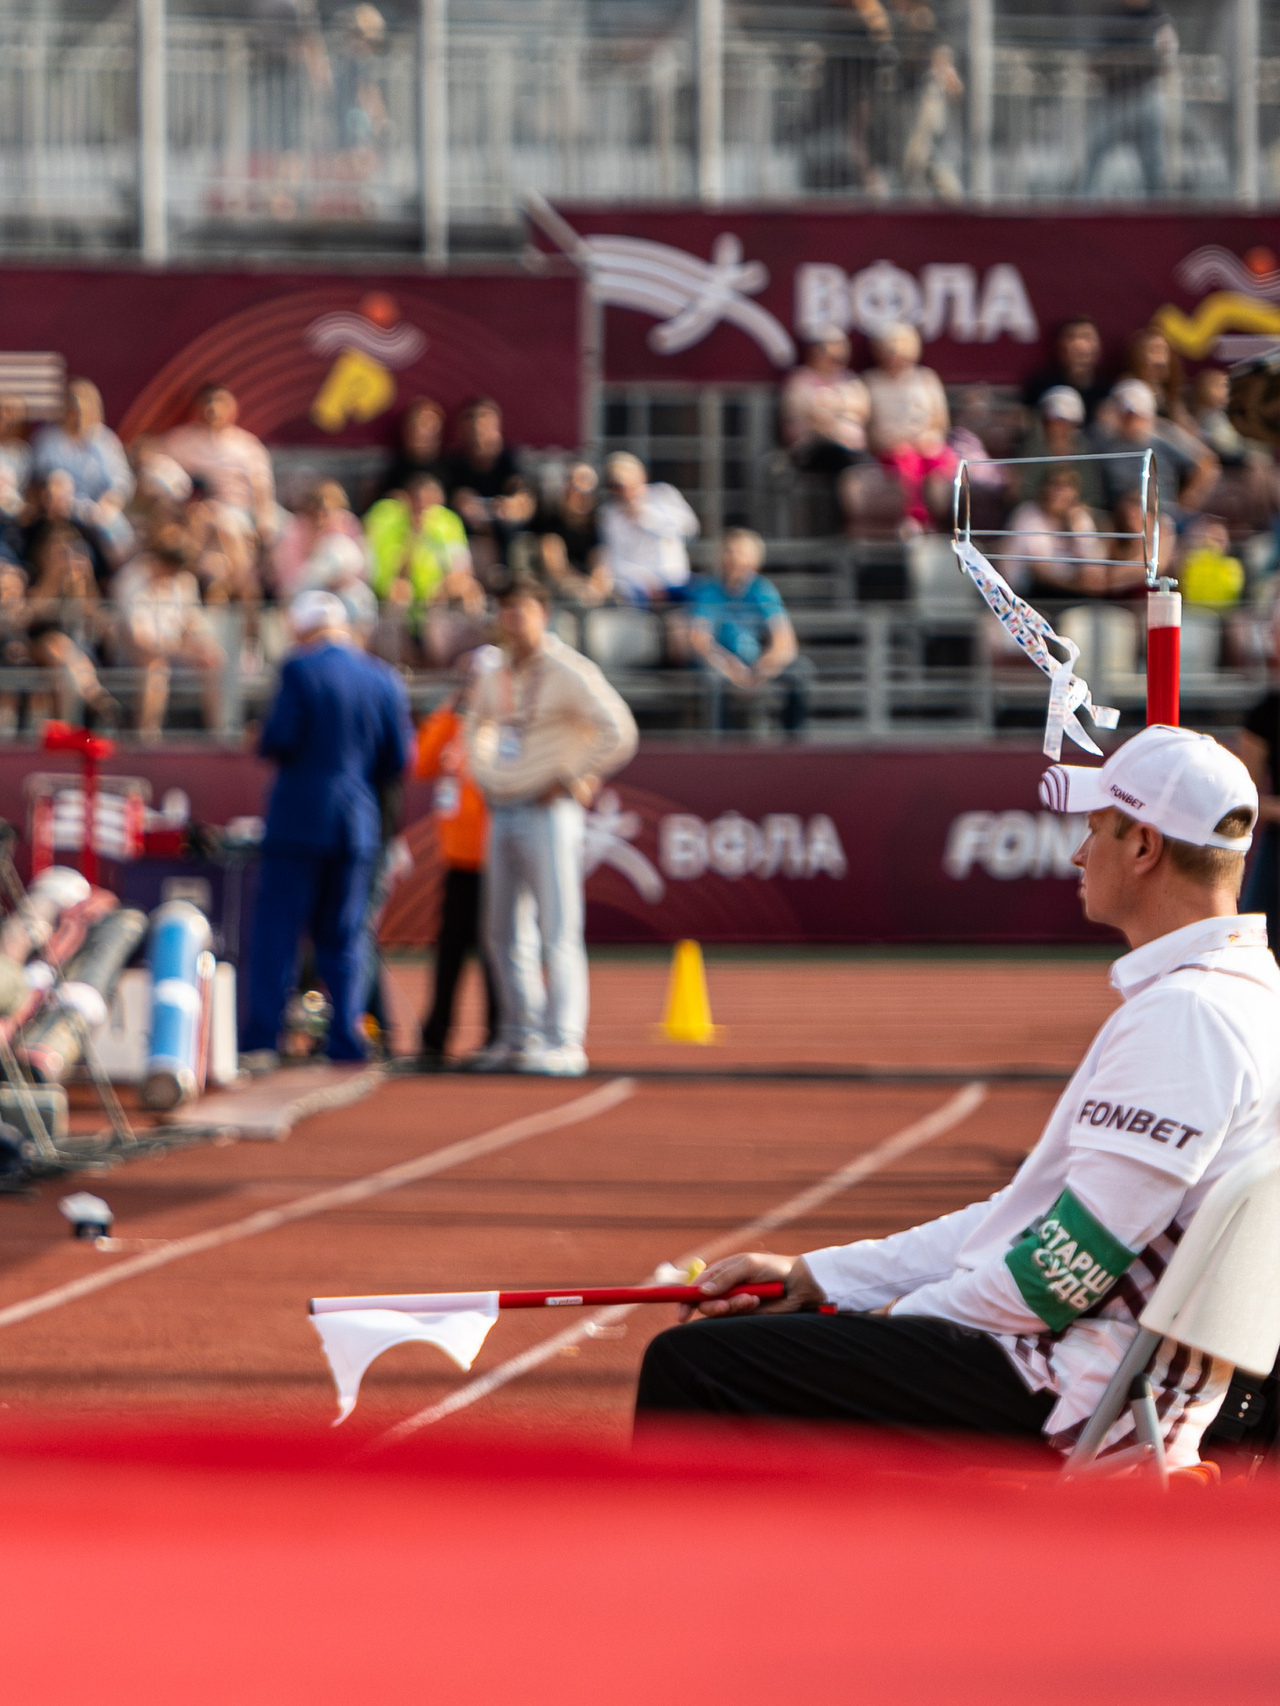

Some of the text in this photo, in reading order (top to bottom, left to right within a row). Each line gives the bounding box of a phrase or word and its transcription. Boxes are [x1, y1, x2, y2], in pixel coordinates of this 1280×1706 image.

[792, 258, 1039, 344] ВФЛА
[1110, 784, 1147, 810] FONBET
[946, 809, 1089, 880] FON
[1078, 1099, 1204, 1150] FONBET
[1032, 1247, 1092, 1310] СУДЬ
[1038, 1218, 1116, 1294] СТАРШ
